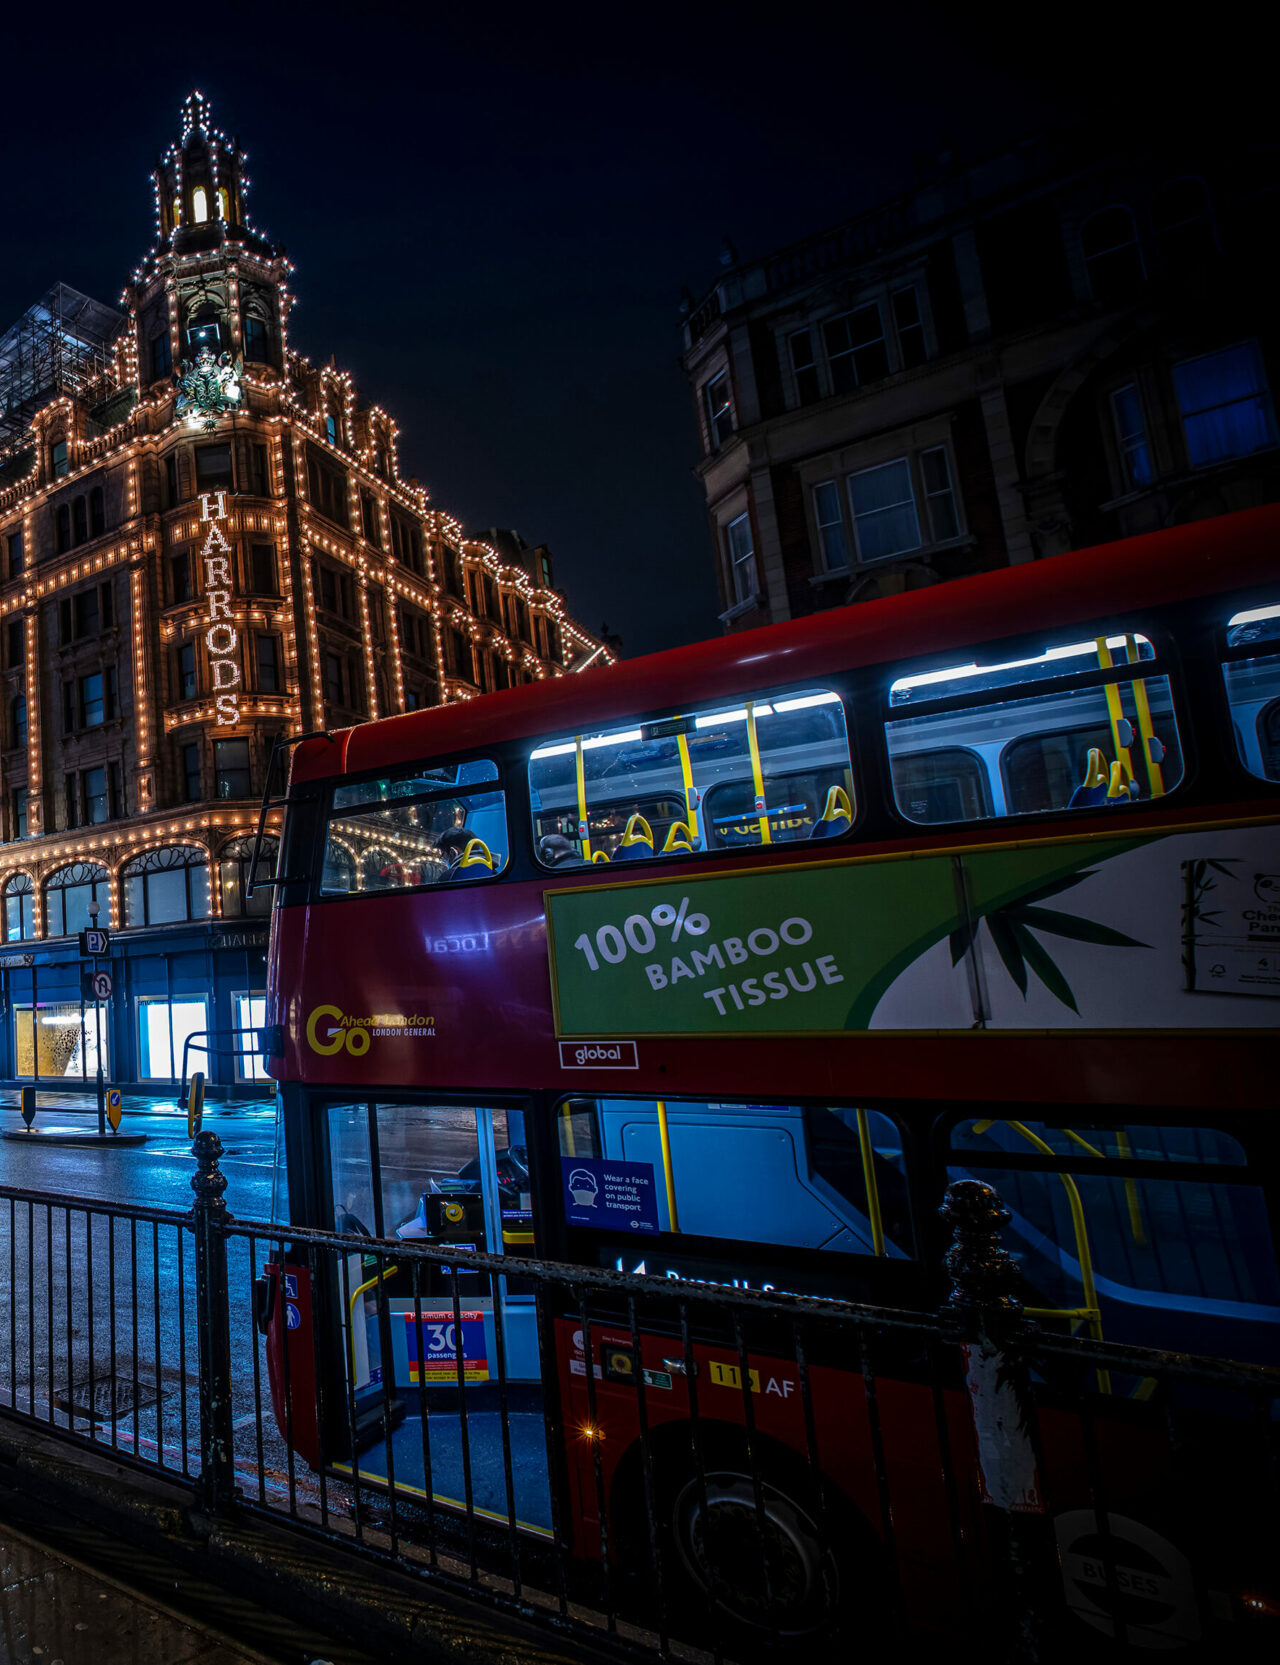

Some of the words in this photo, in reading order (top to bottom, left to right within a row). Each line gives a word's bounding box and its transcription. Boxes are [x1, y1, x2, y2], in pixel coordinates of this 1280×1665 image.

[197, 490, 241, 726] HARRODS
[574, 896, 711, 971] 100%
[645, 917, 813, 990] BAMBOO
[703, 955, 844, 1016] TISSUE
[306, 1004, 370, 1056] Go
[372, 1027, 401, 1036] LONDON
[404, 1027, 436, 1036] GENERAL
[575, 1045, 621, 1064] global
[604, 1174, 623, 1182] Wear
[631, 1176, 649, 1185] face
[604, 1184, 637, 1194] covering
[606, 1201, 641, 1211] transport
[617, 1194, 641, 1202] public
[447, 1311, 478, 1319] caacity
[427, 1324, 464, 1351] 30
[427, 1352, 467, 1360] passengs
[764, 1376, 795, 1399] AF
